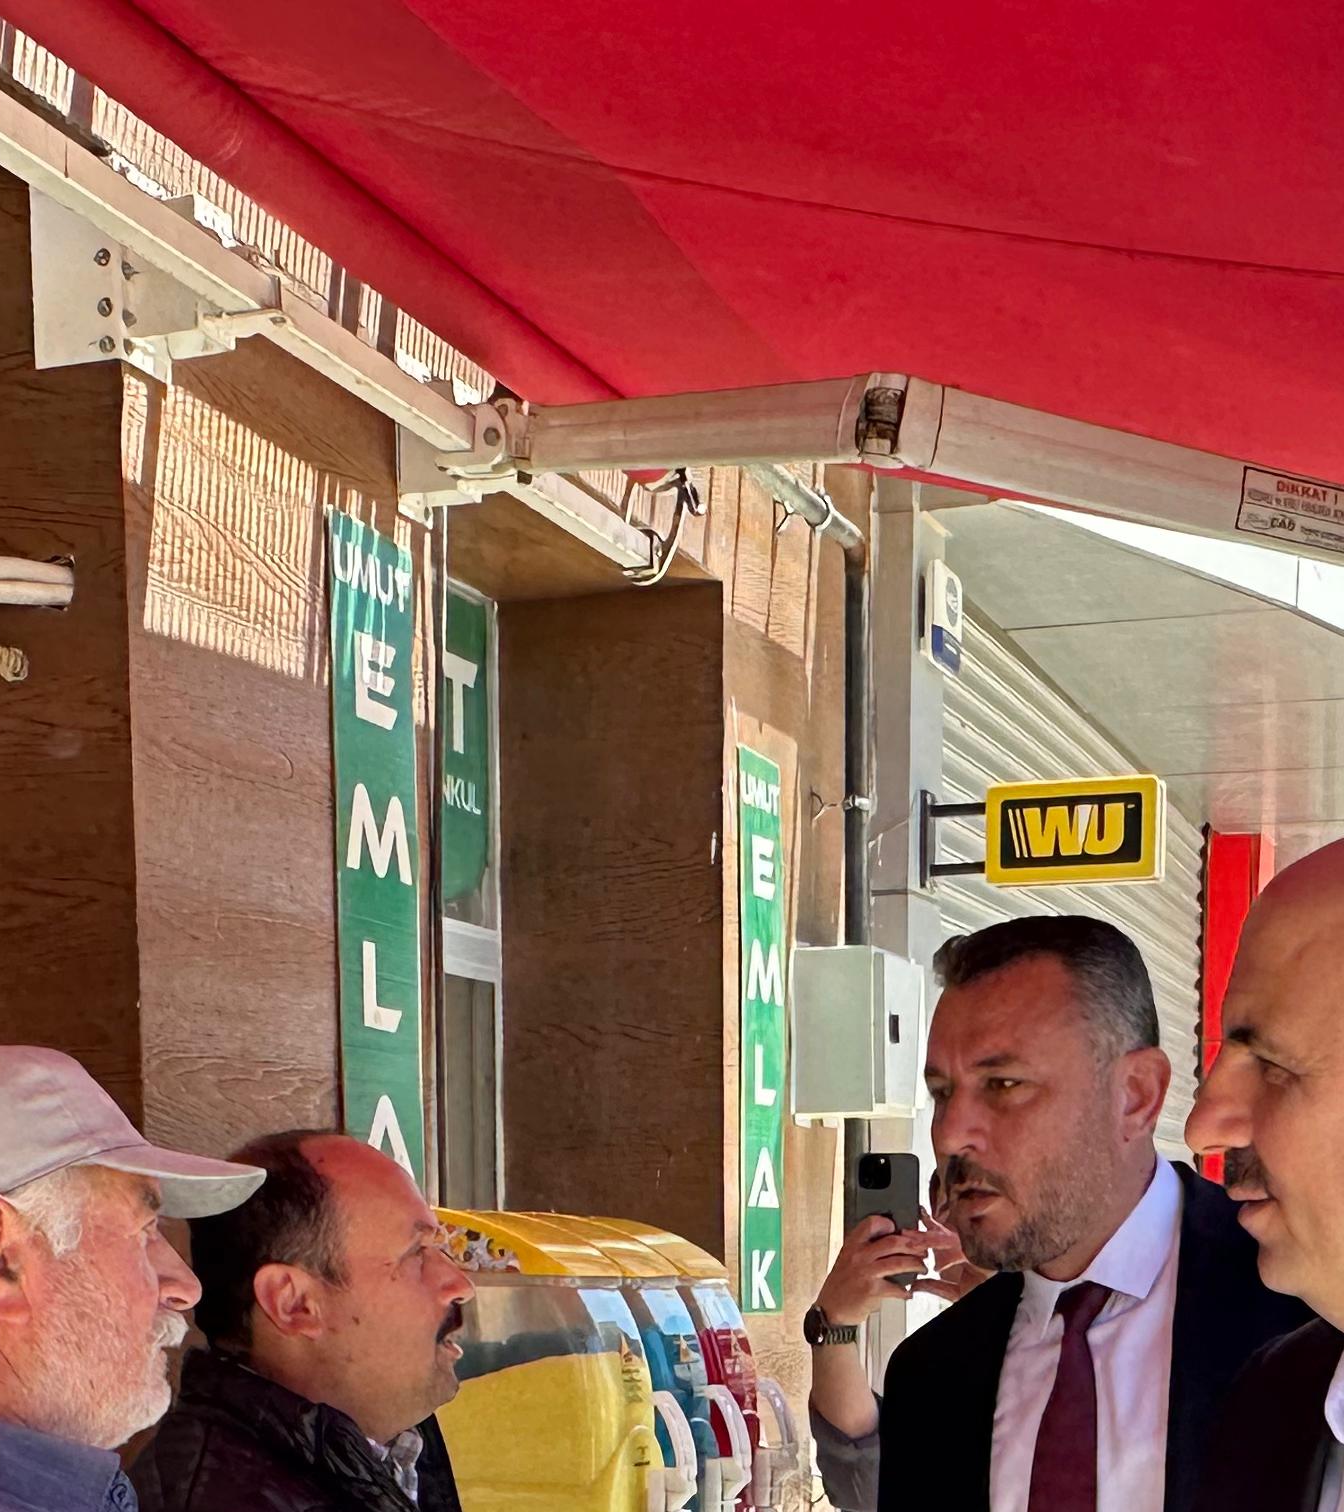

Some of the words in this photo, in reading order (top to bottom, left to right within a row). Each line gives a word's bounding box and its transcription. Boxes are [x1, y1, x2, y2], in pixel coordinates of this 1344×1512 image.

[332, 533, 412, 613] UMUT
[740, 770, 781, 817] UMUT
[1022, 803, 1125, 858] WU
[746, 834, 783, 1309] EMLAK
